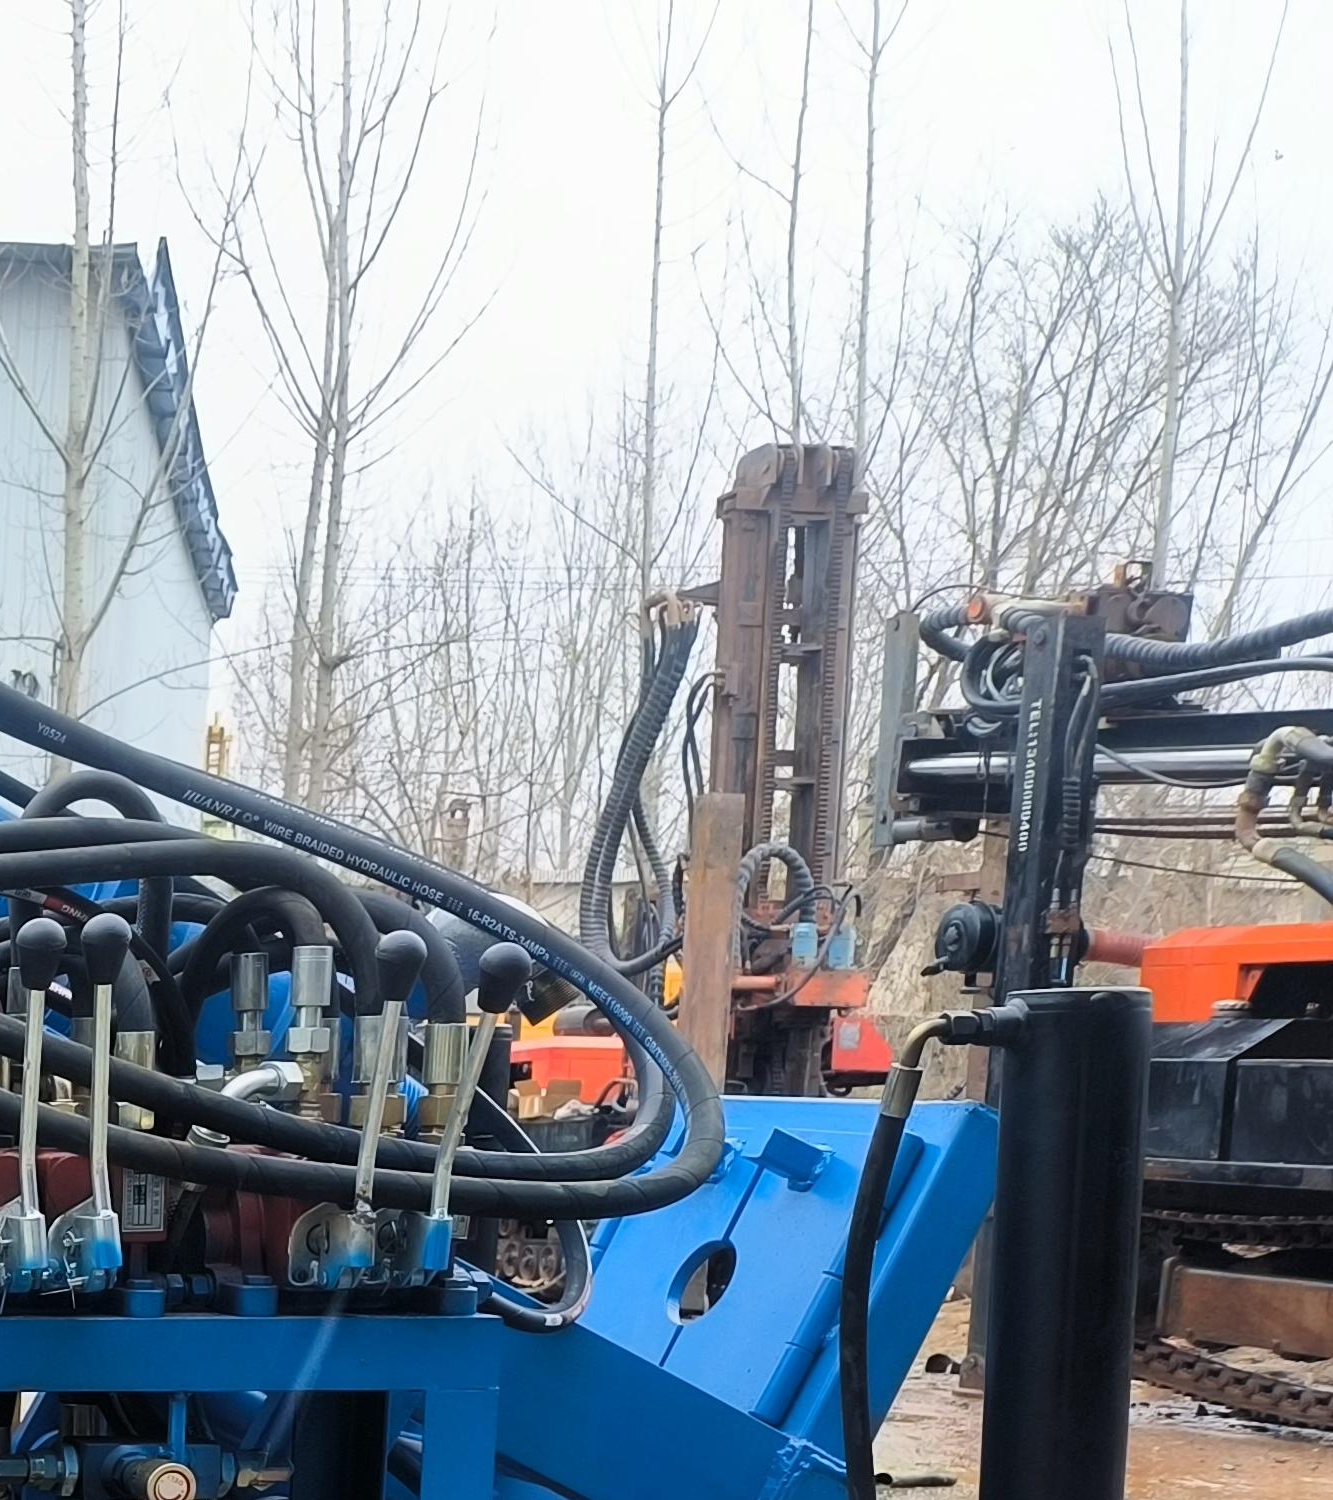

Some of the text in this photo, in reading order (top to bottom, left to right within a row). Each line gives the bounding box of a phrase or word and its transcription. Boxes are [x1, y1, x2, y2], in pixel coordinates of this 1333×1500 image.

[36, 721, 68, 745] Y0524
[262, 818, 293, 840] WIRE
[293, 832, 345, 861] BRAIDED
[345, 852, 412, 889] HYDRAULIC
[411, 882, 445, 904] HOSE
